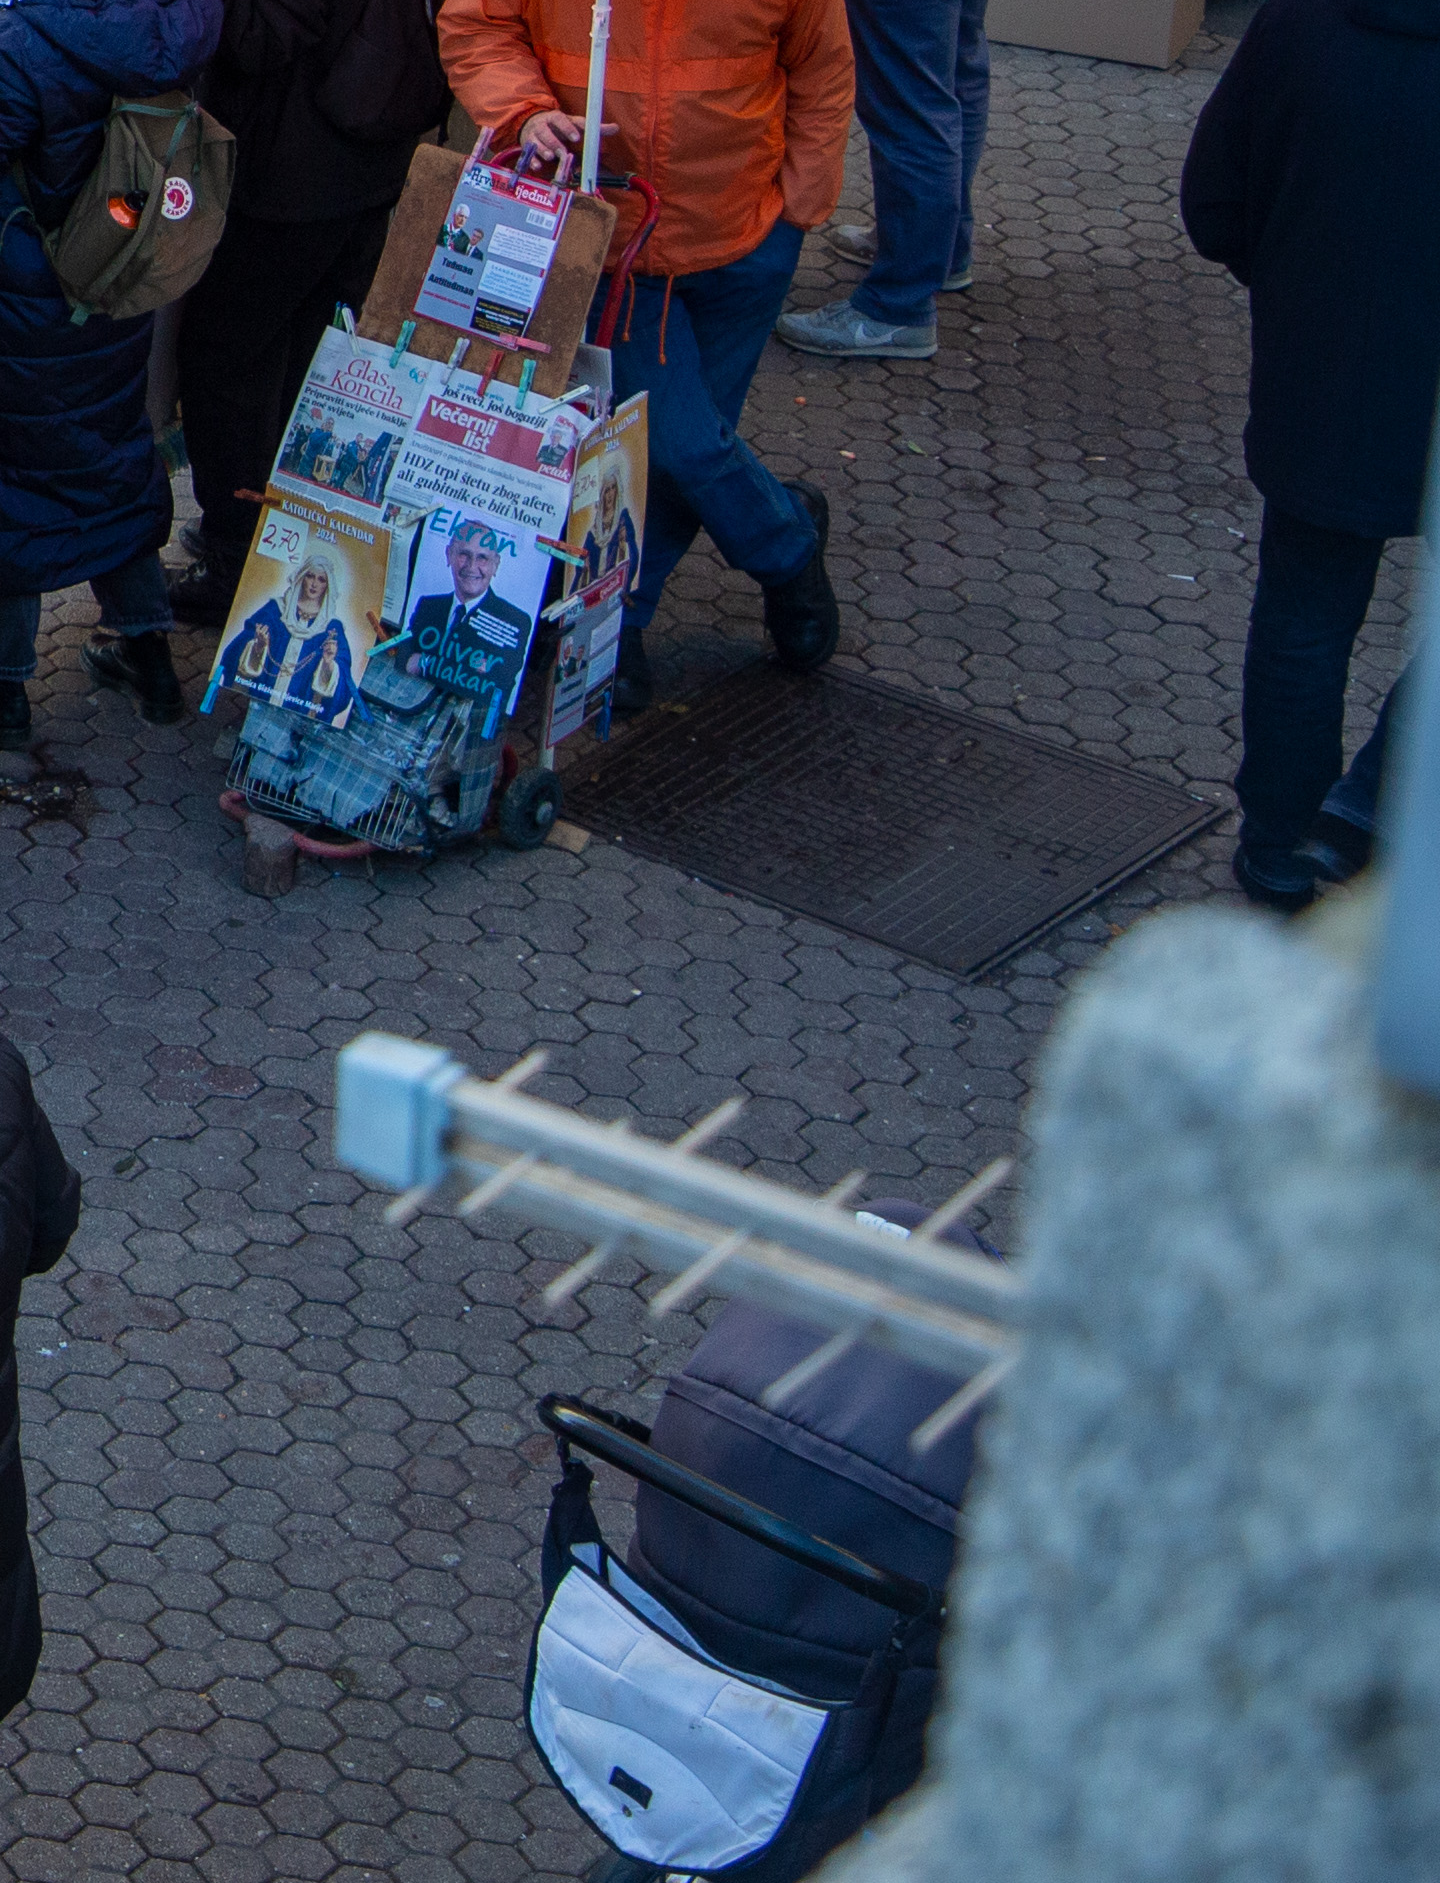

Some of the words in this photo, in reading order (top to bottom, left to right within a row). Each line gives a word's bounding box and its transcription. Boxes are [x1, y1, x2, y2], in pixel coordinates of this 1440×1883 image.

[330, 369, 404, 411] Koncila
[347, 358, 388, 387] Glas
[301, 396, 310, 404] za
[327, 403, 355, 420] svijeta
[304, 385, 346, 406] Pripraviti
[380, 412, 408, 428] baklje
[429, 400, 499, 435] Večernji
[487, 398, 504, 415] još
[505, 405, 548, 430] bogatiji
[461, 429, 491, 453] list
[403, 451, 435, 473] HDZ
[435, 464, 459, 483] trpi
[460, 473, 491, 494] štetu
[492, 483, 522, 506] zbog
[522, 495, 556, 518] afere,
[537, 463, 570, 482] petak
[396, 468, 413, 483] ali
[413, 476, 469, 504] gubitnik
[470, 495, 487, 510] će
[488, 499, 511, 517] biti
[511, 507, 543, 529] Most
[261, 523, 301, 553] 2,70
[281, 499, 327, 528] KATOLIČKI
[329, 514, 376, 547] KALENDAR
[430, 507, 518, 558] Ekran
[418, 625, 505, 674] Oliver
[419, 651, 496, 693] Mlakar
